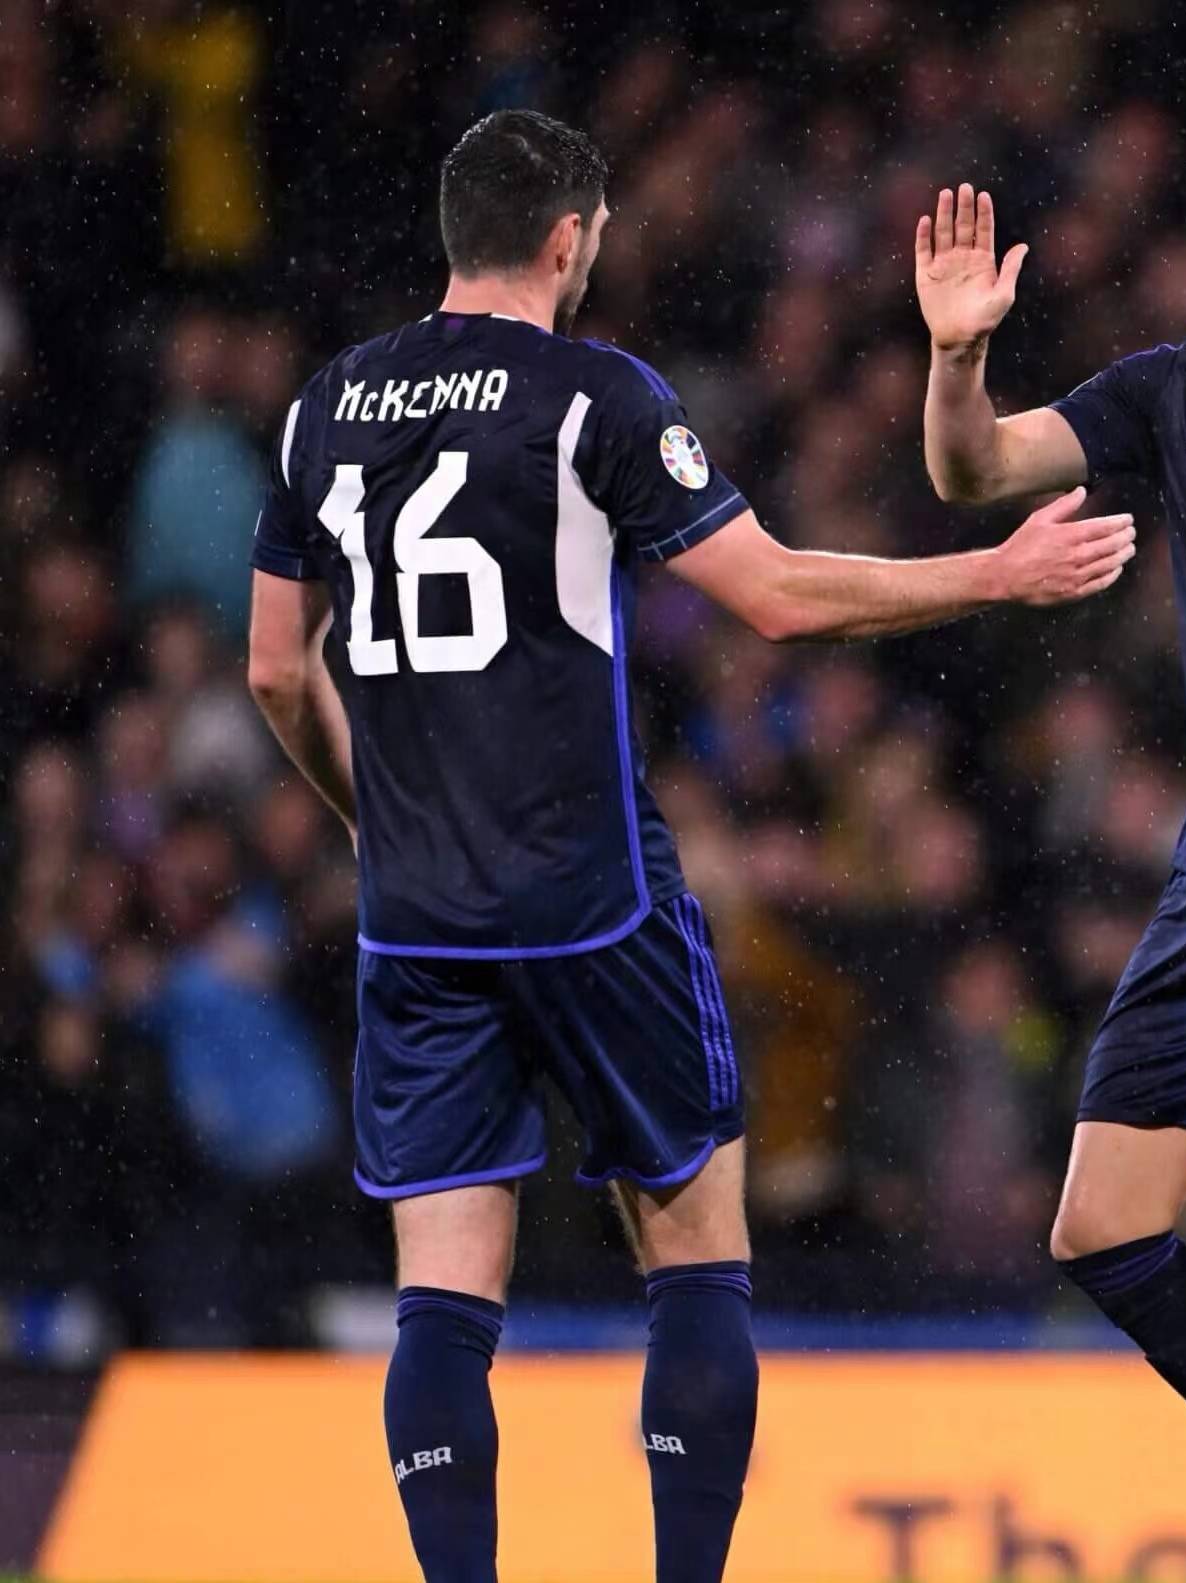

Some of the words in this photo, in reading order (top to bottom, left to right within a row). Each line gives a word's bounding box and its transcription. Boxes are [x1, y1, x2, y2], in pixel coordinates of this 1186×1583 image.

[334, 369, 508, 422] McKENNA
[318, 451, 508, 676] 16
[395, 1446, 452, 1484] ALBA
